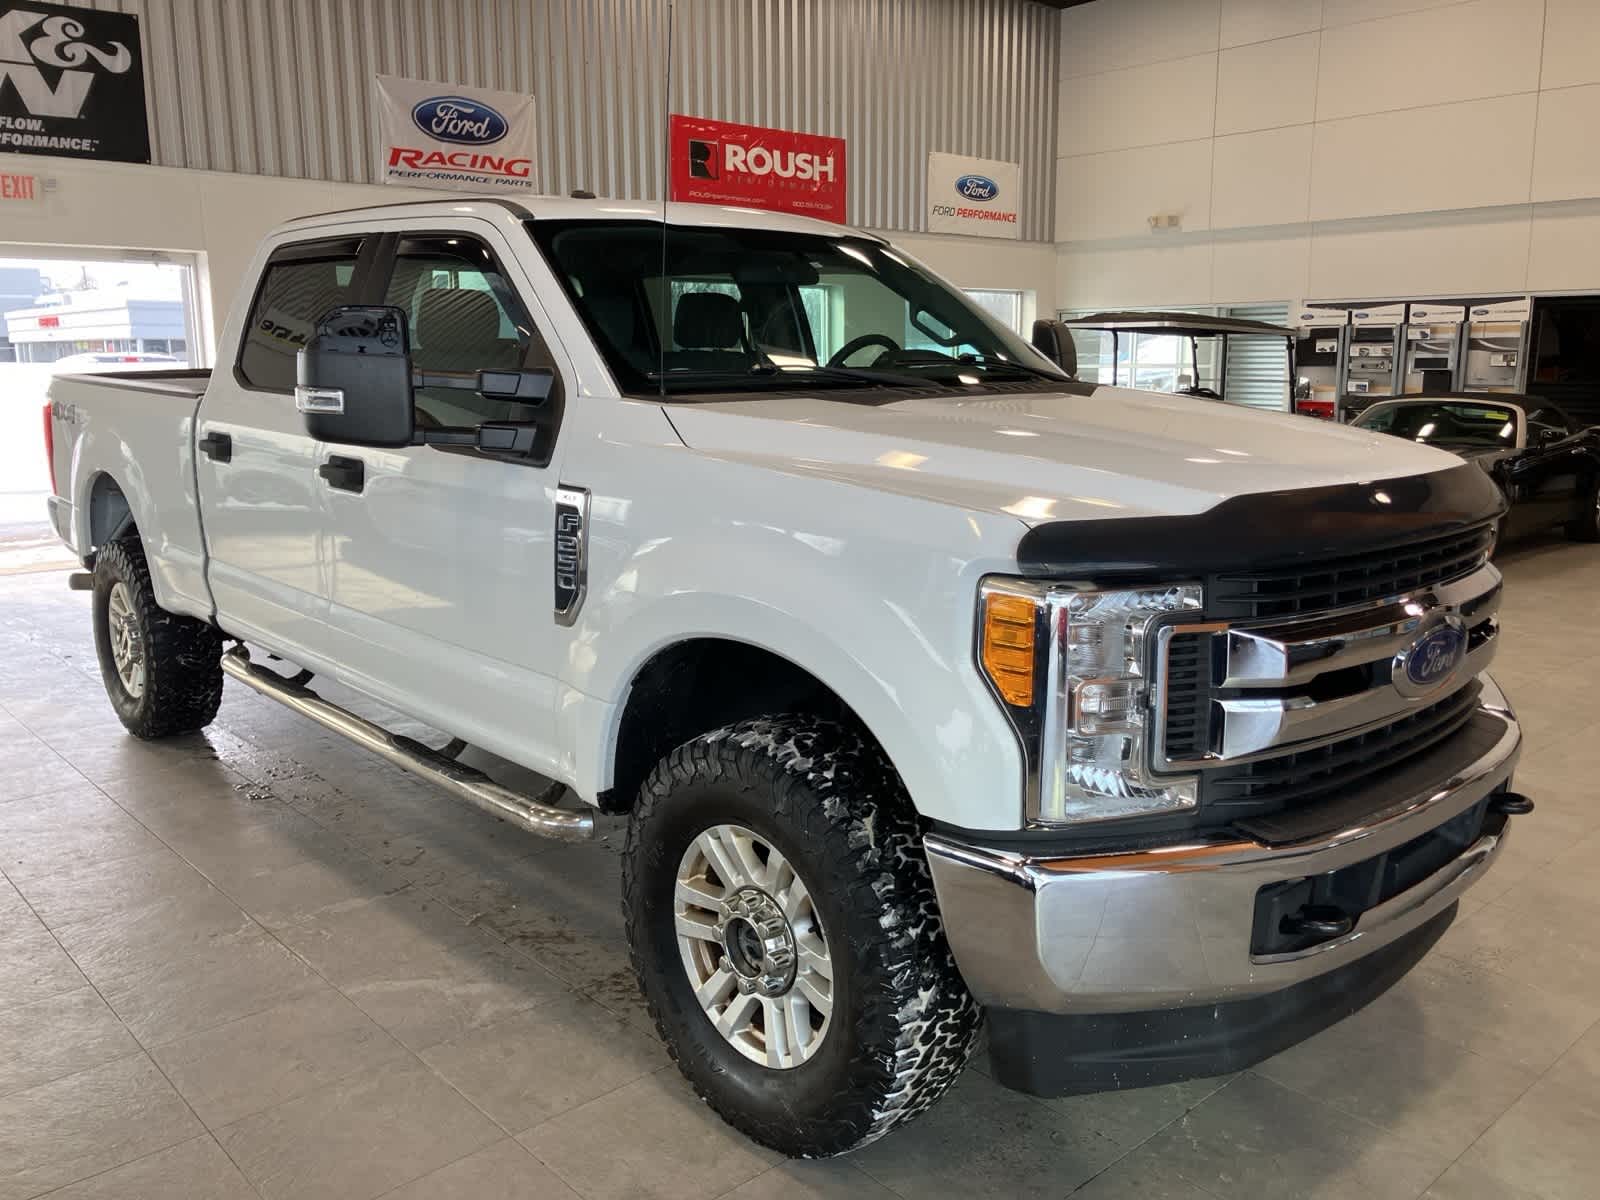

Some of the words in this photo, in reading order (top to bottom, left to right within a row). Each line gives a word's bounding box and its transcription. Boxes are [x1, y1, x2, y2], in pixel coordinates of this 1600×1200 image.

[431, 103, 490, 138] Ford
[388, 147, 532, 178] RACING
[725, 143, 834, 183] ROUSH
[0, 175, 34, 200] EXIT
[389, 169, 491, 184] PERFORMANCE
[495, 178, 533, 188] PARTS
[963, 178, 992, 198] Ford
[932, 205, 956, 217] FORD
[956, 207, 1017, 224] PERFORMANCE
[1421, 640, 1456, 678] Ford
